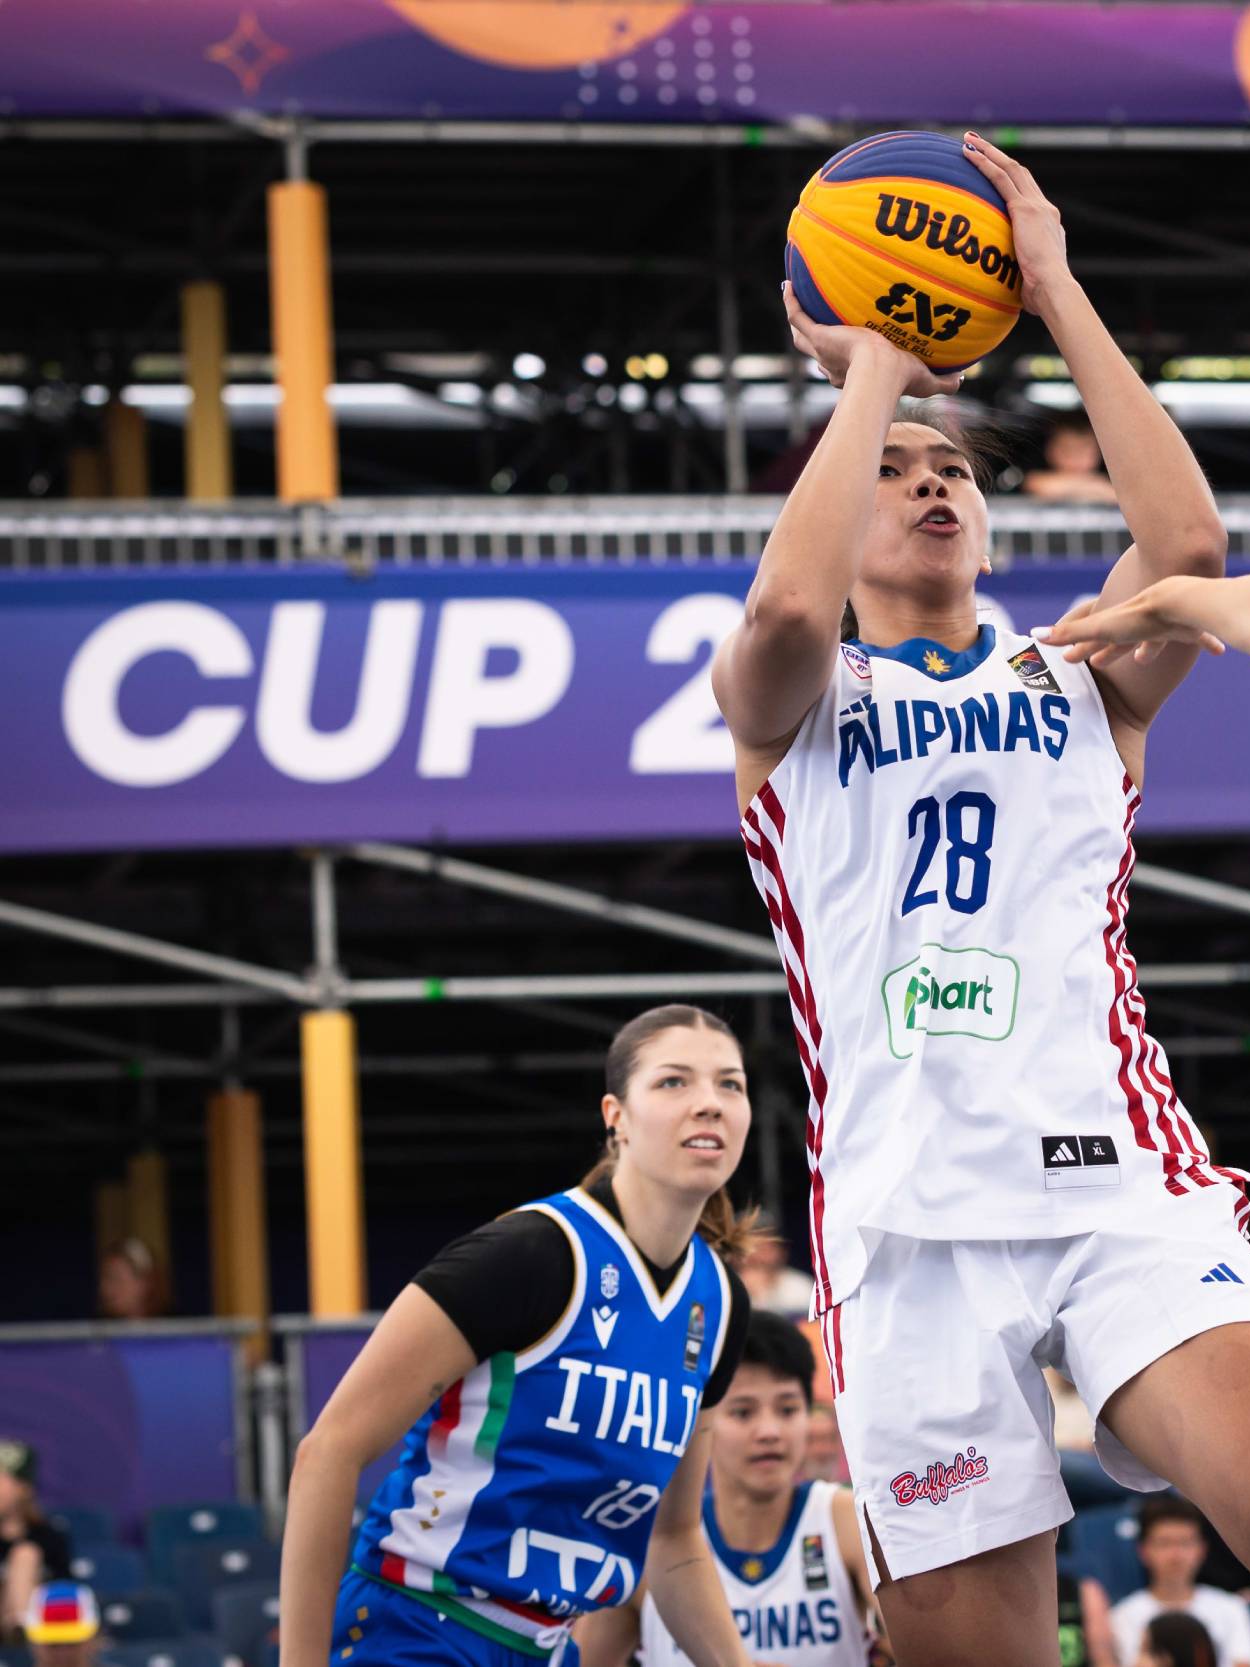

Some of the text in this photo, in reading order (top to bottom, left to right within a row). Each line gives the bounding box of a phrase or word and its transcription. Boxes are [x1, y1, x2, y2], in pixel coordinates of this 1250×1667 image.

[875, 193, 1021, 291] Wilson
[865, 320, 935, 358] OFFICIAL BALL
[883, 321, 908, 338] FIBA
[61, 599, 576, 788] CUP
[901, 790, 997, 918] 28
[1092, 1146, 1106, 1156] XL
[545, 1357, 703, 1458] ITALI
[582, 1479, 661, 1530] 18
[731, 1598, 842, 1651] PINAS
